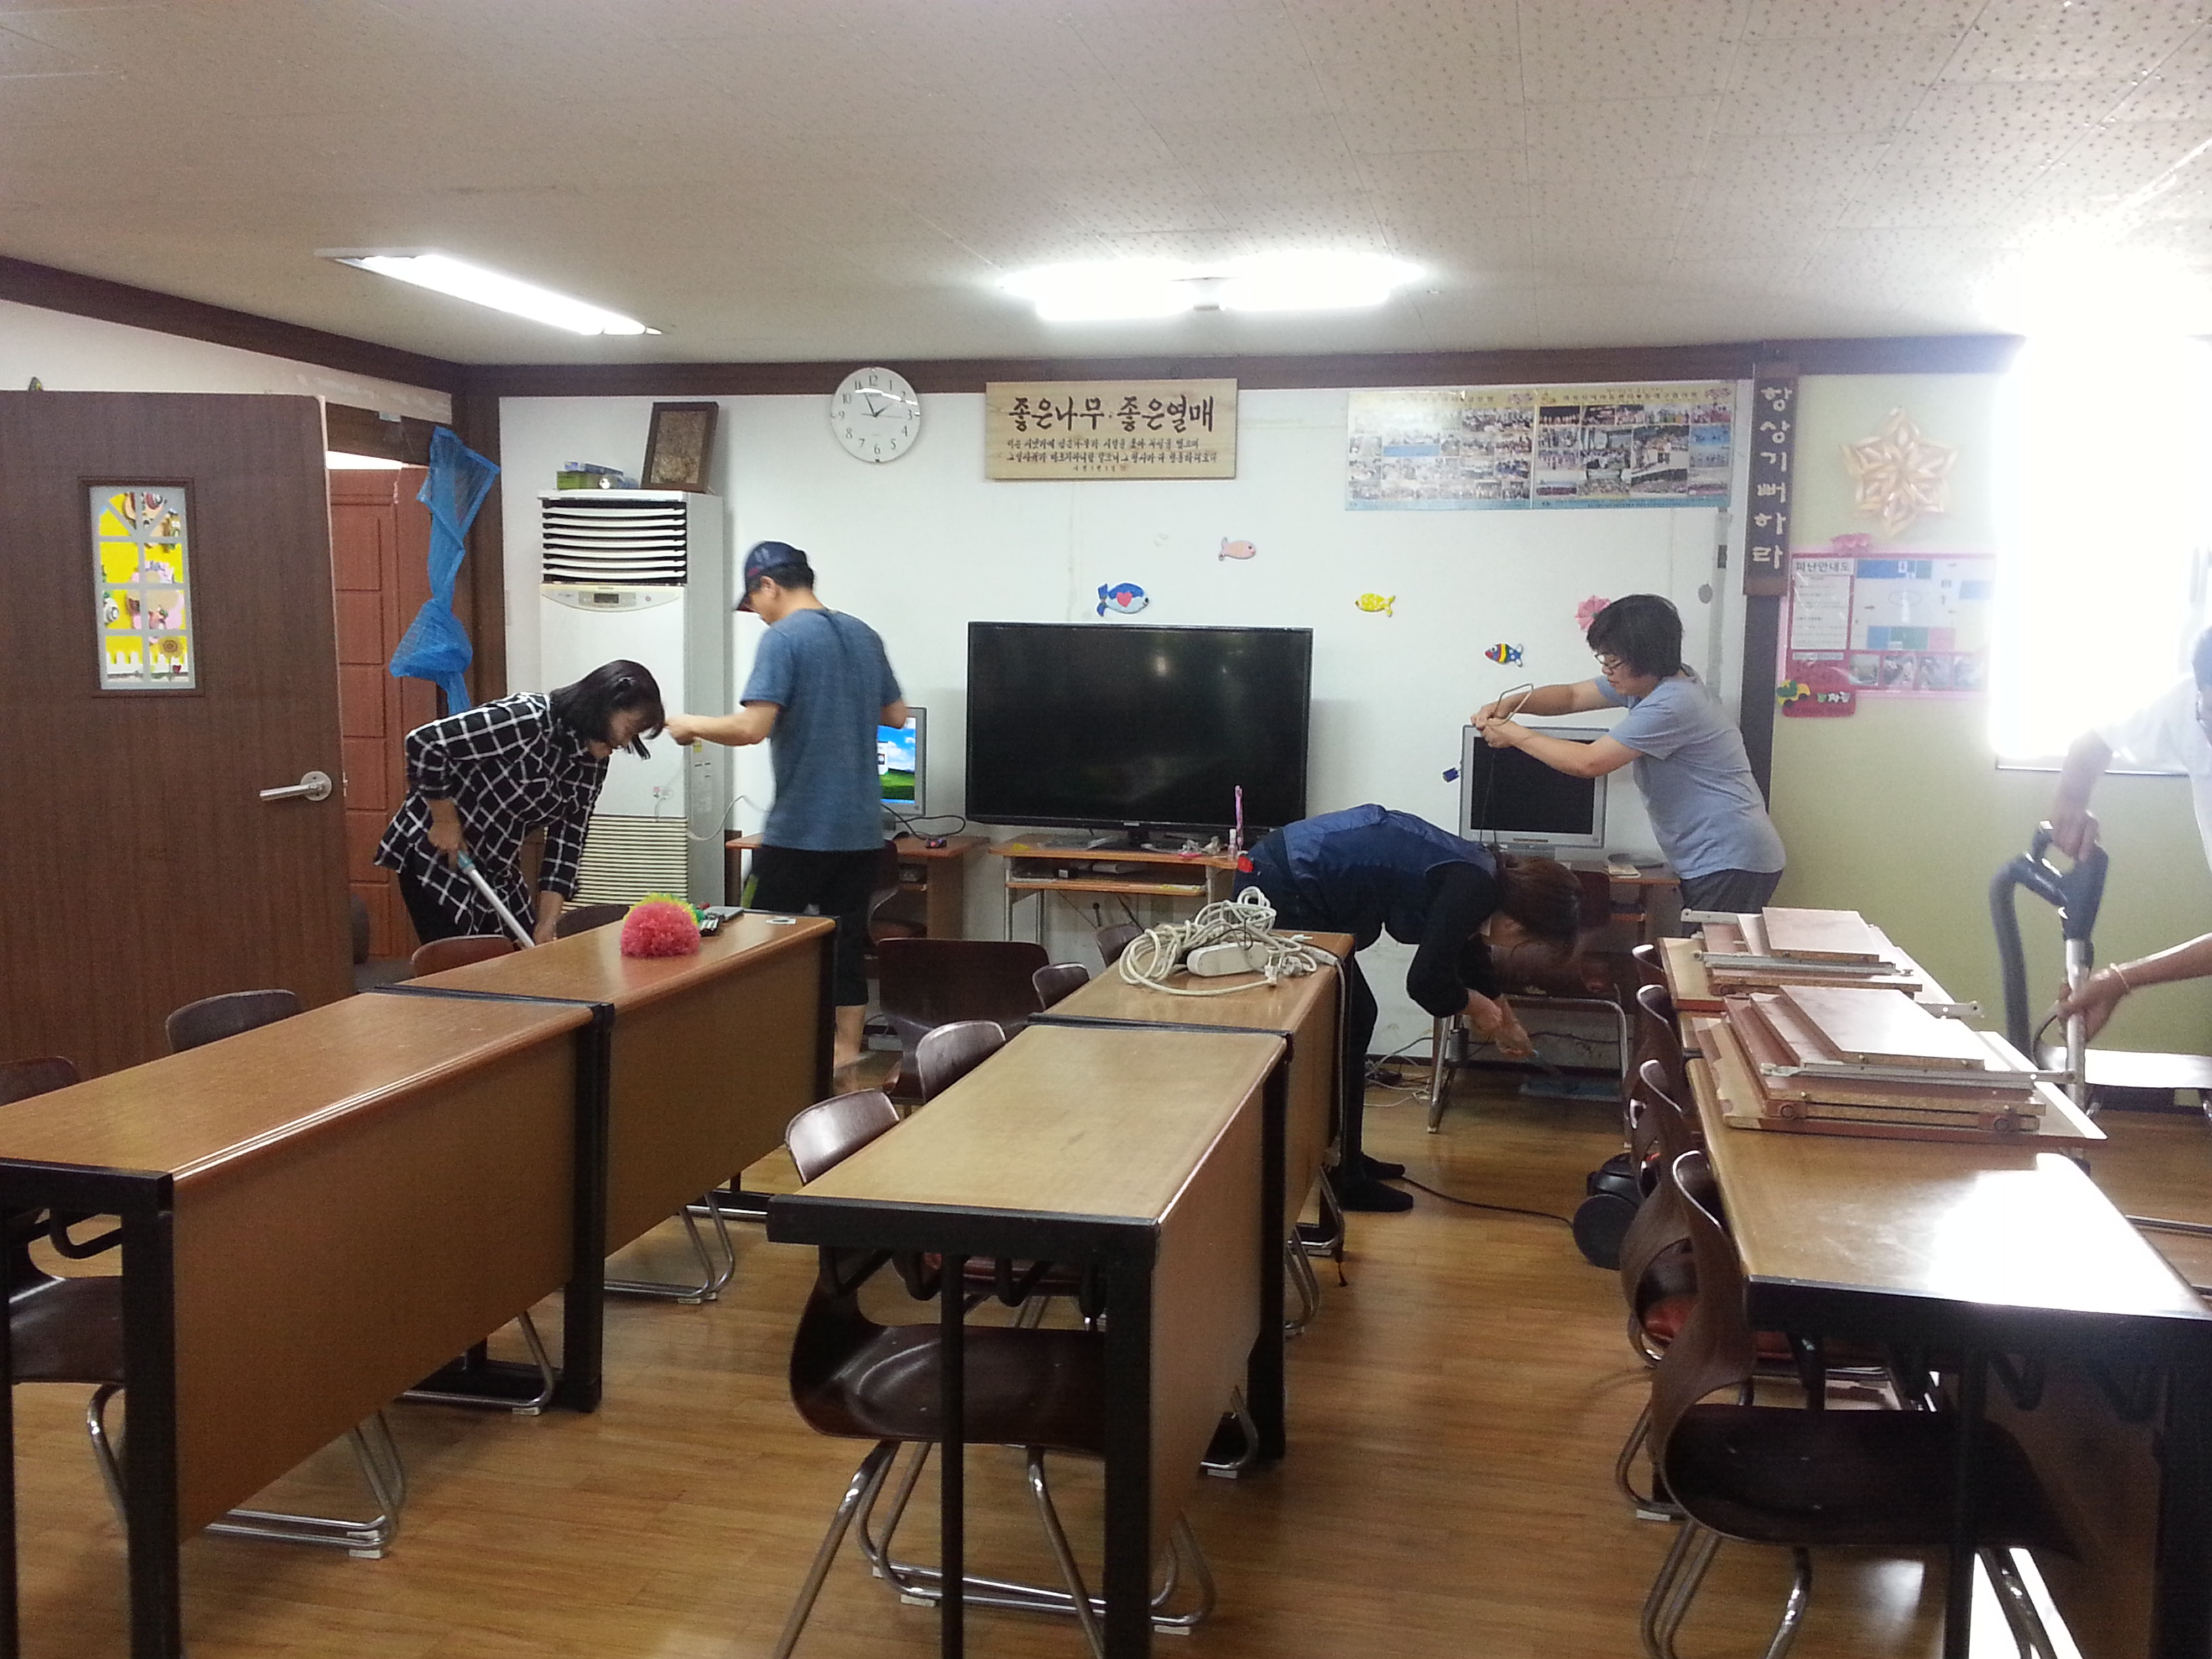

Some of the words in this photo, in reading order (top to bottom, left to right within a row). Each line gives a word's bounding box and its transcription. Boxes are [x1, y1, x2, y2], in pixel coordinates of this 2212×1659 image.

[869, 375, 878, 387] 12
[842, 393, 852, 405] 10
[838, 411, 845, 419] 9
[907, 409, 913, 420] 3
[845, 428, 853, 439] 8
[901, 426, 908, 436] 4
[859, 438, 865, 448] 7
[890, 438, 897, 450] 5
[874, 444, 880, 455] 6
